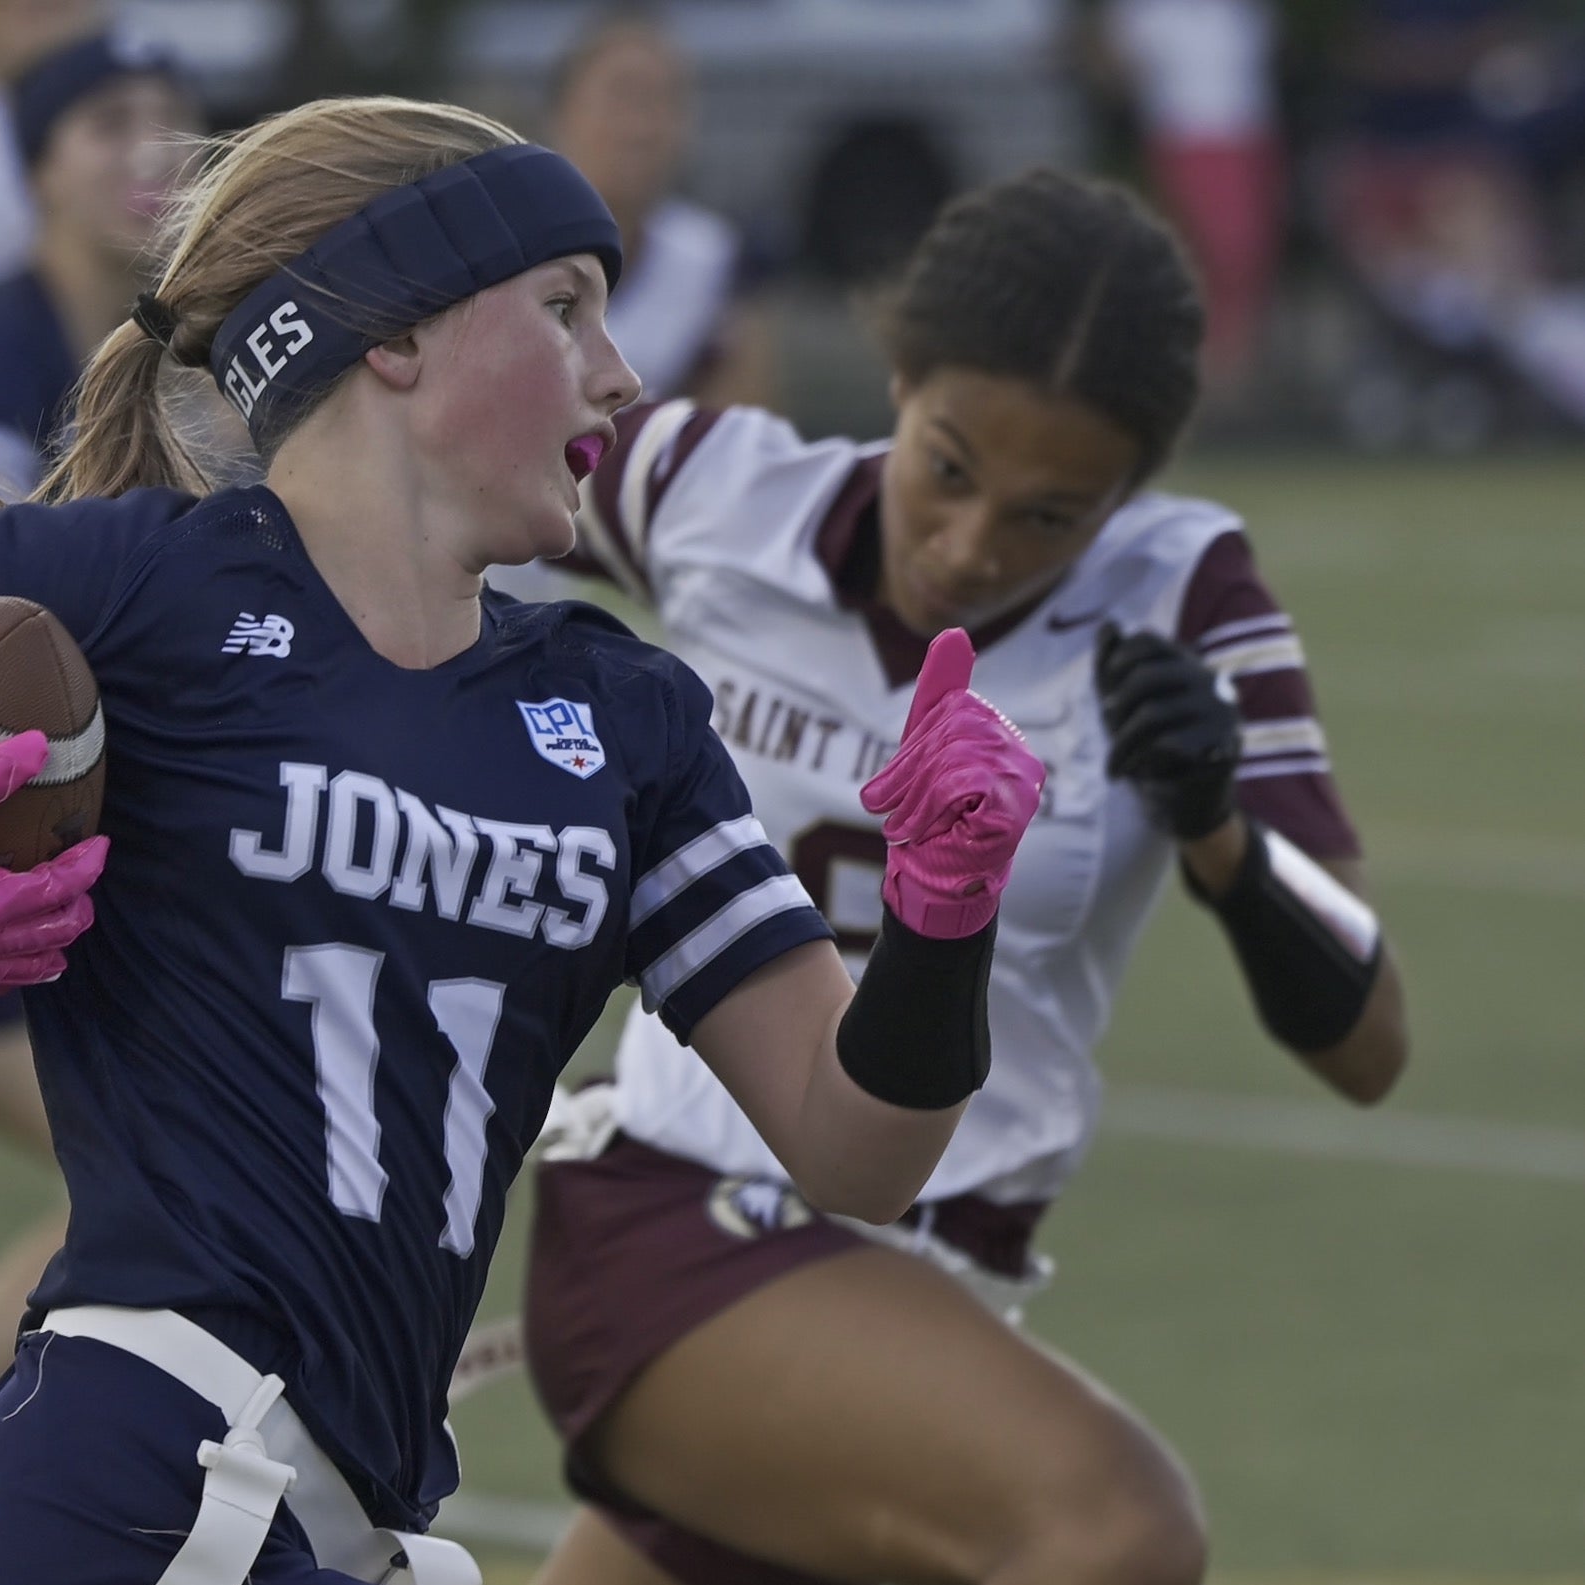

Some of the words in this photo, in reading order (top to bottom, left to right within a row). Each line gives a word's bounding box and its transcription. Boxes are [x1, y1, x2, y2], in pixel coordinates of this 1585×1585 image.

[524, 702, 595, 739] CPL
[228, 761, 616, 951] JONES
[280, 941, 508, 1260] 11
